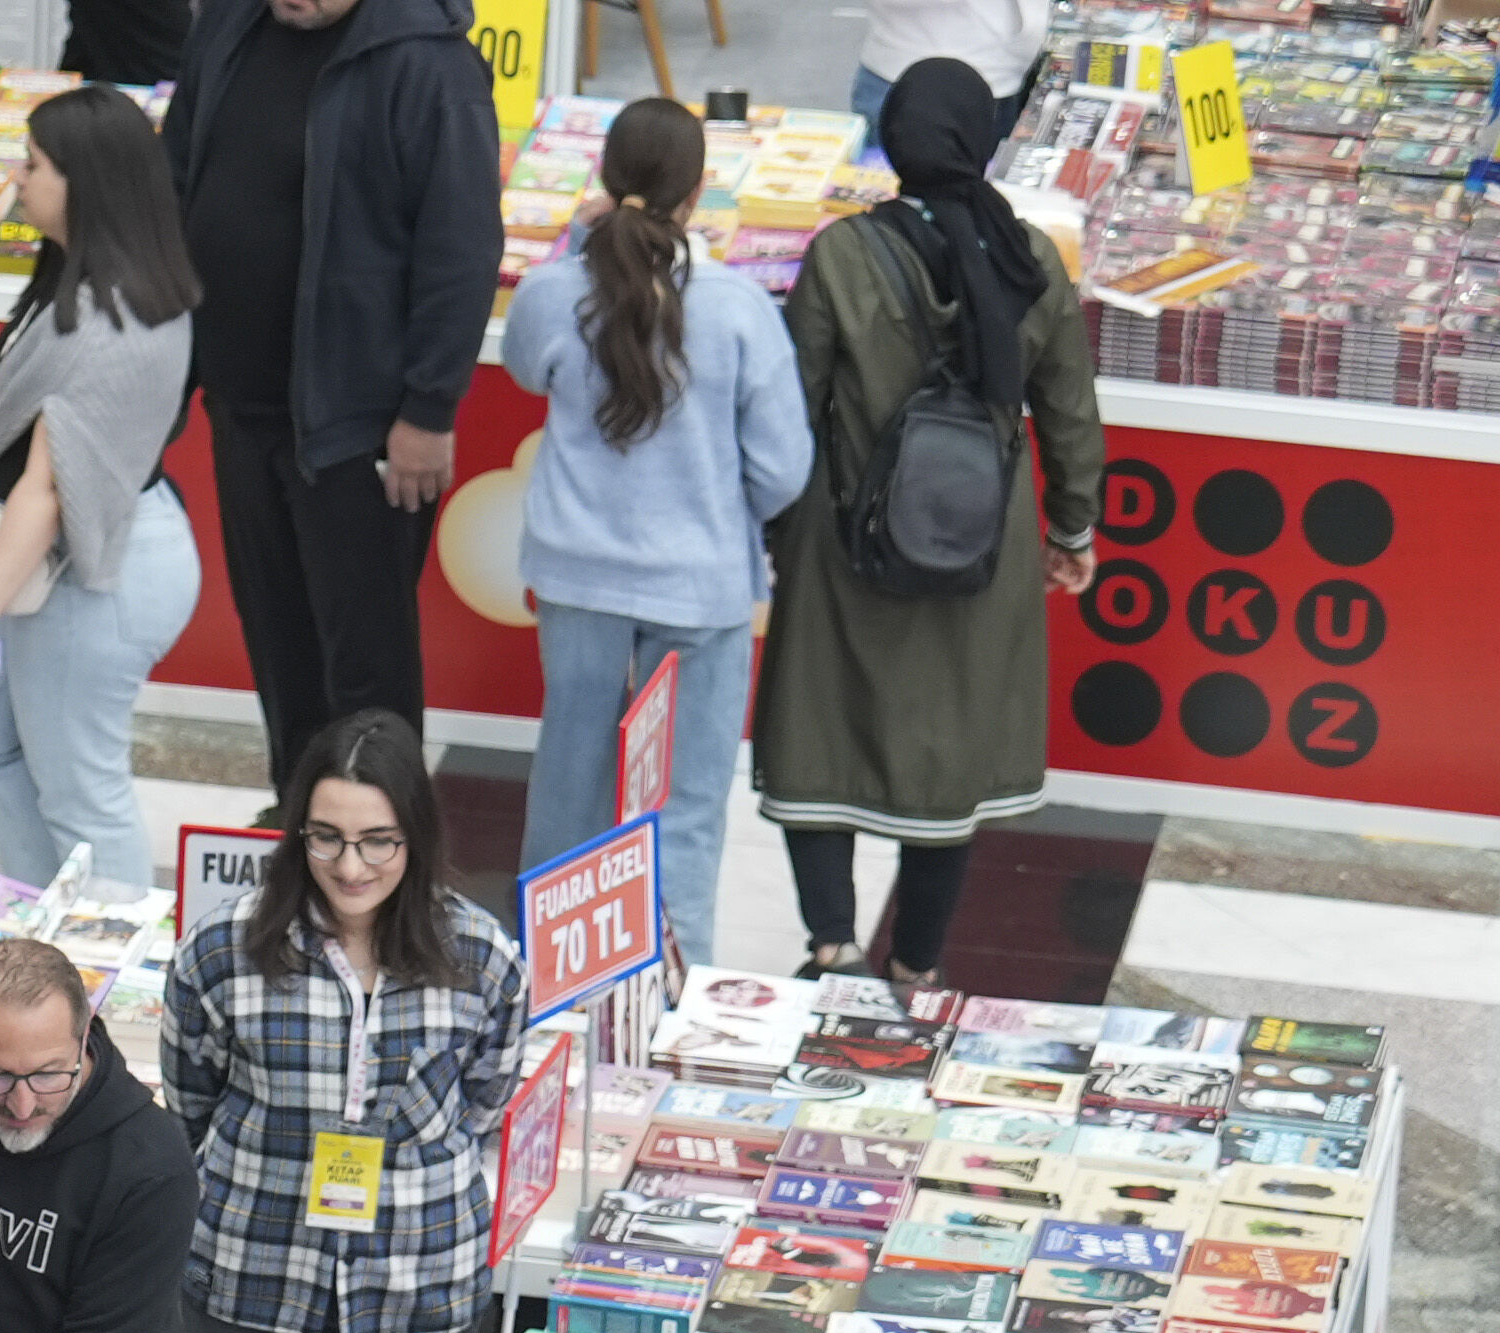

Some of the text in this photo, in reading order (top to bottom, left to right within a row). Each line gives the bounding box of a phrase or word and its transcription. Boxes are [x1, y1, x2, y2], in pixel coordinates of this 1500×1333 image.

[1184, 87, 1230, 147] 100
[535, 843, 647, 927] FUARA ÖZEL
[550, 898, 633, 982] 70 TL
